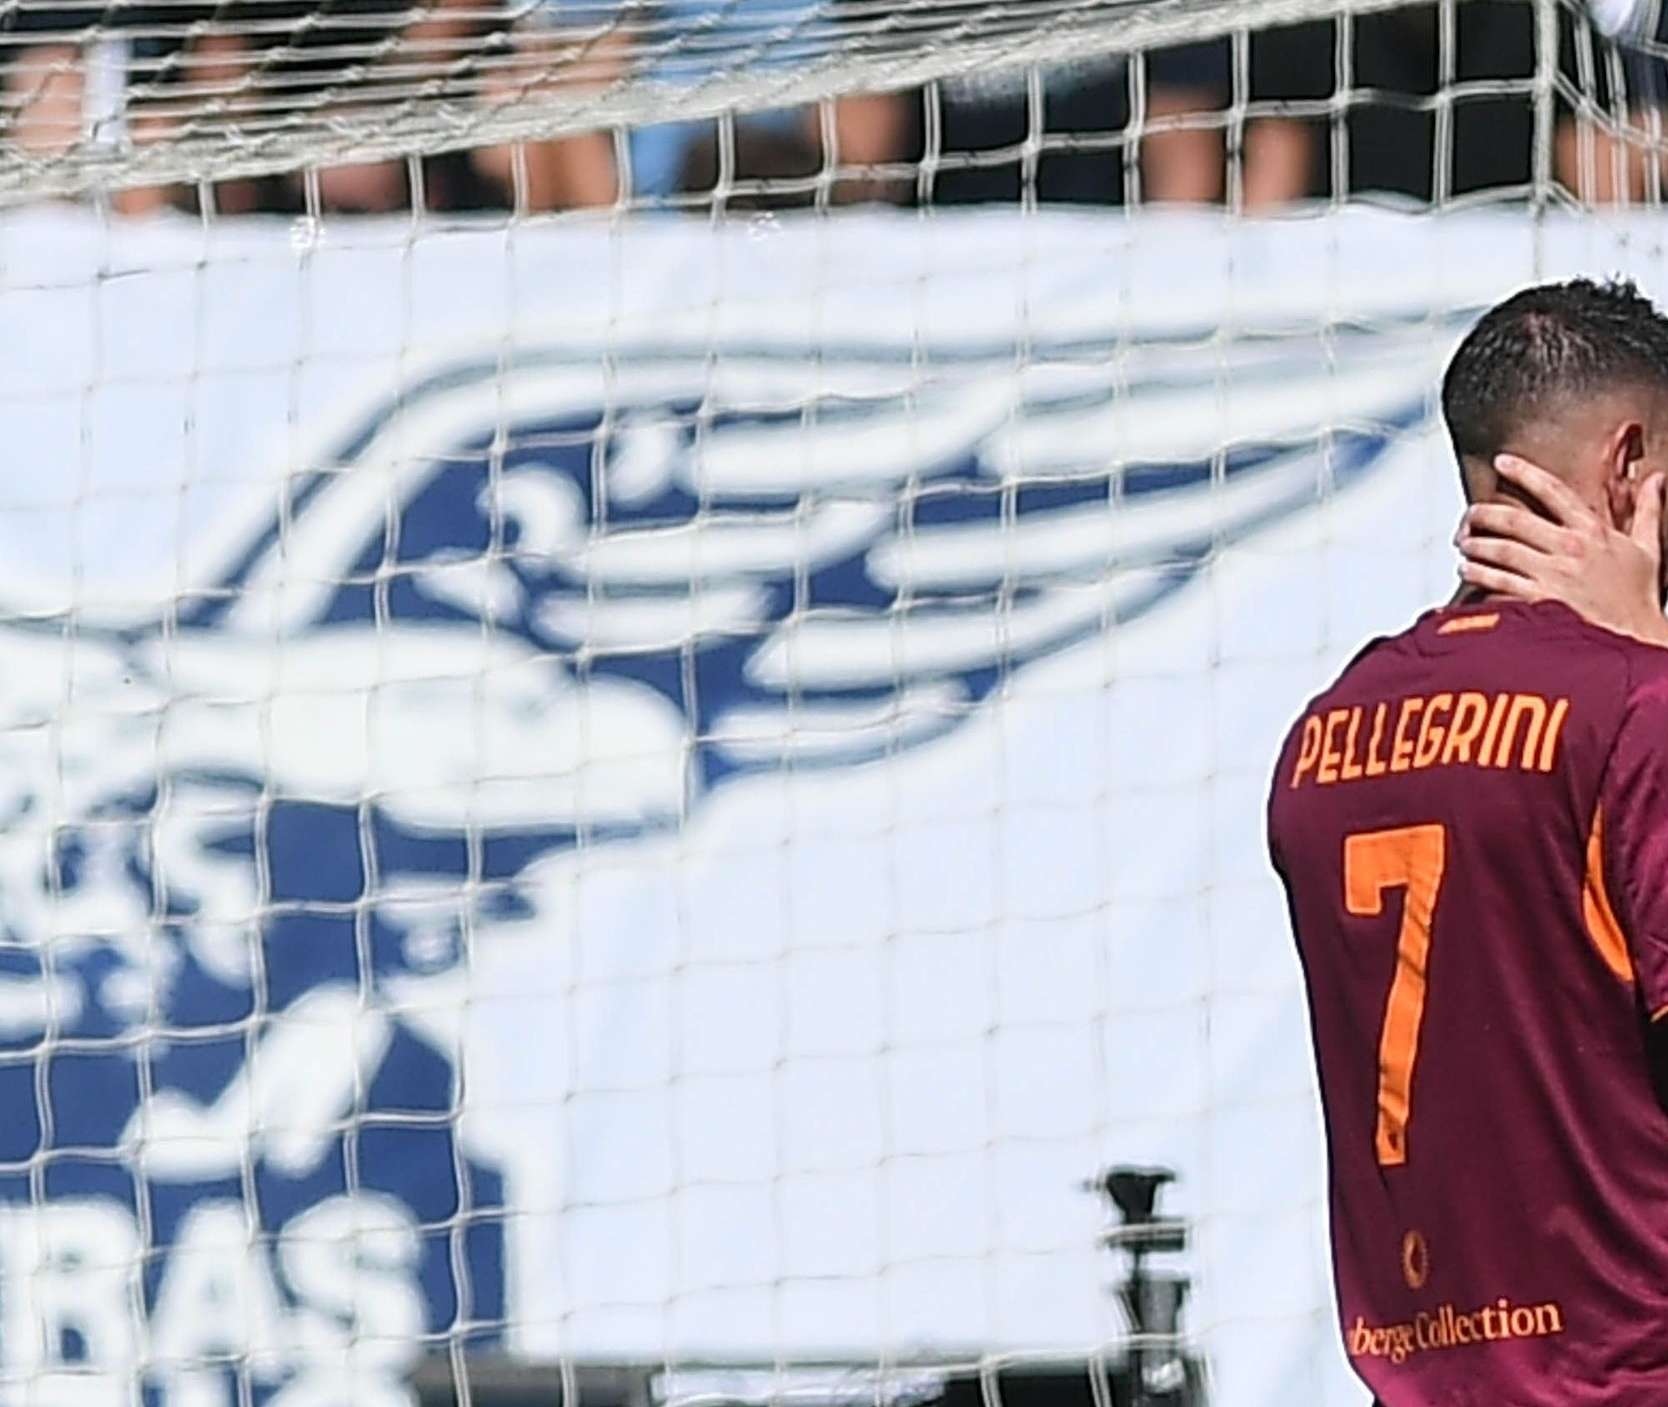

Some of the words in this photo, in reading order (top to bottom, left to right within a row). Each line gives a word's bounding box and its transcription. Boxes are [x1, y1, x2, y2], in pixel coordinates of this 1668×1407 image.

[1292, 692, 1569, 789] PELLEGRINI
[1343, 823, 1447, 1166] 7
[1415, 1298, 1563, 1350] Collection
